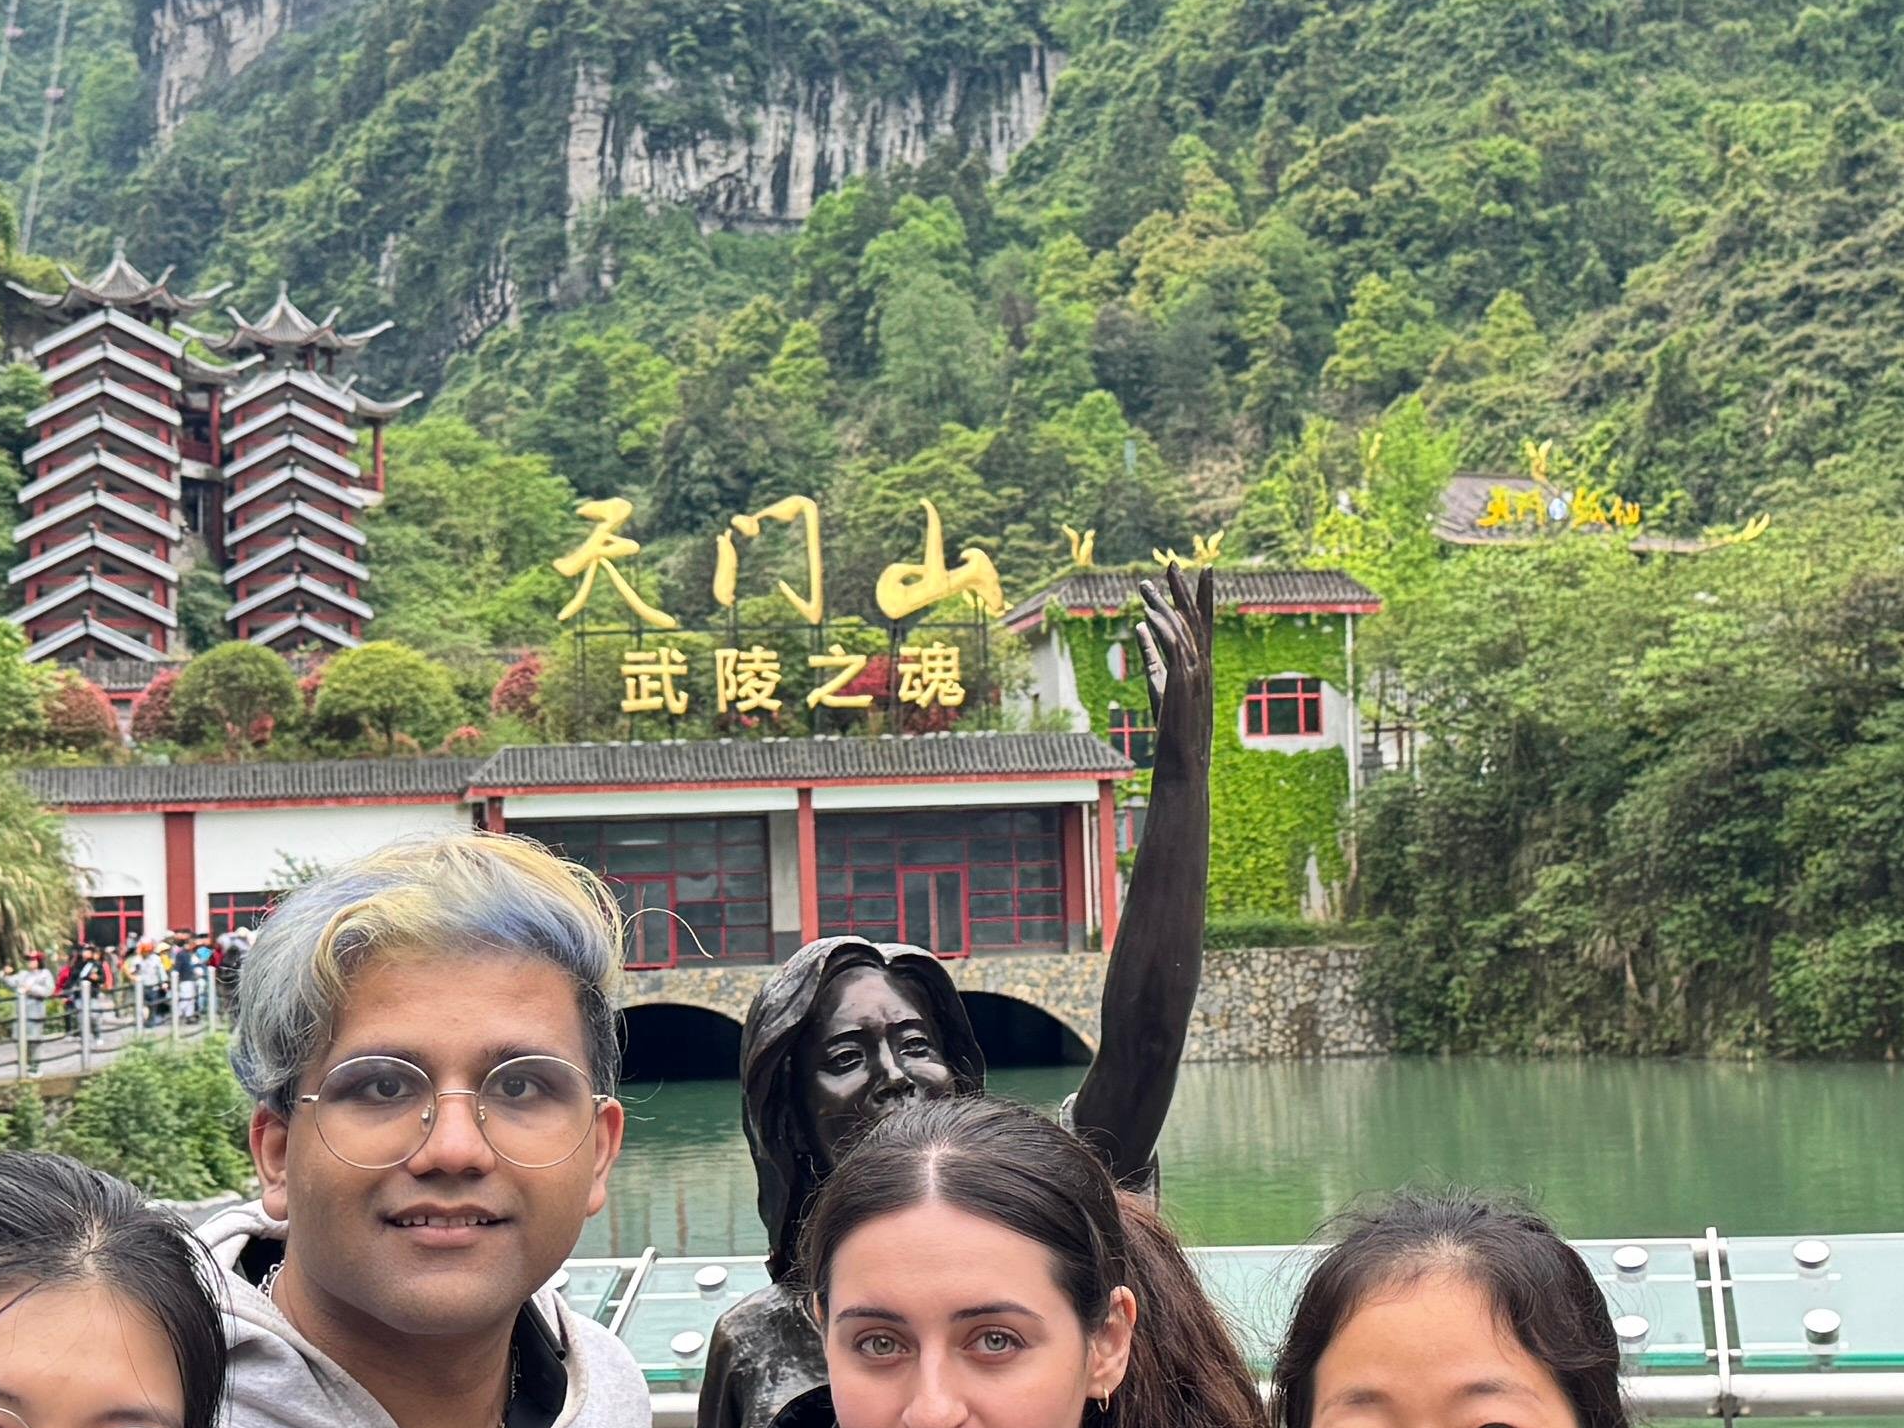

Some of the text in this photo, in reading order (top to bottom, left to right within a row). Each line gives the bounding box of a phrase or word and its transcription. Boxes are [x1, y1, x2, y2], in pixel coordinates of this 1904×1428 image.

[552, 495, 1004, 629] 天门山
[620, 642, 965, 715] 武陵之魂
